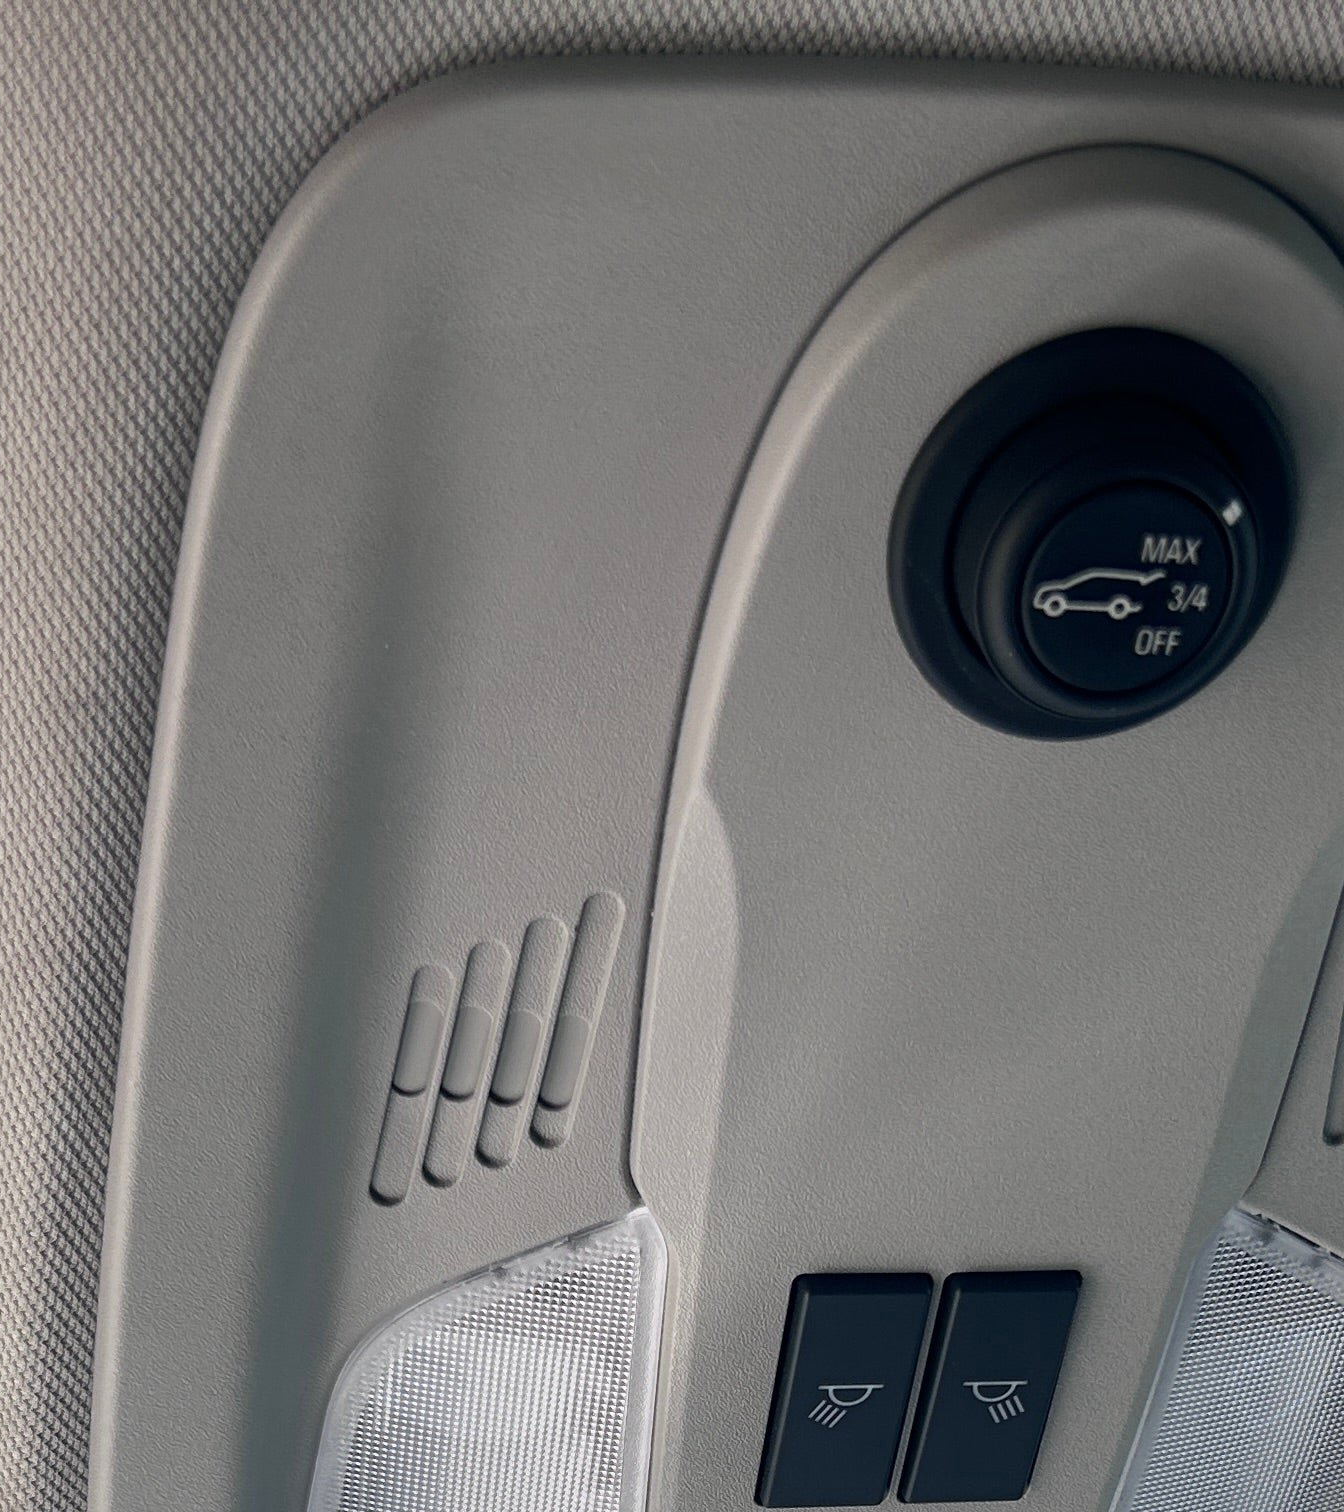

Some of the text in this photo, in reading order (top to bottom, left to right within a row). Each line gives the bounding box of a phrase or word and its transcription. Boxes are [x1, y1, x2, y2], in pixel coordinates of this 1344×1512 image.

[1141, 536, 1202, 565] MAX
[1167, 584, 1209, 613] 3/4
[1134, 629, 1183, 657] OFF
